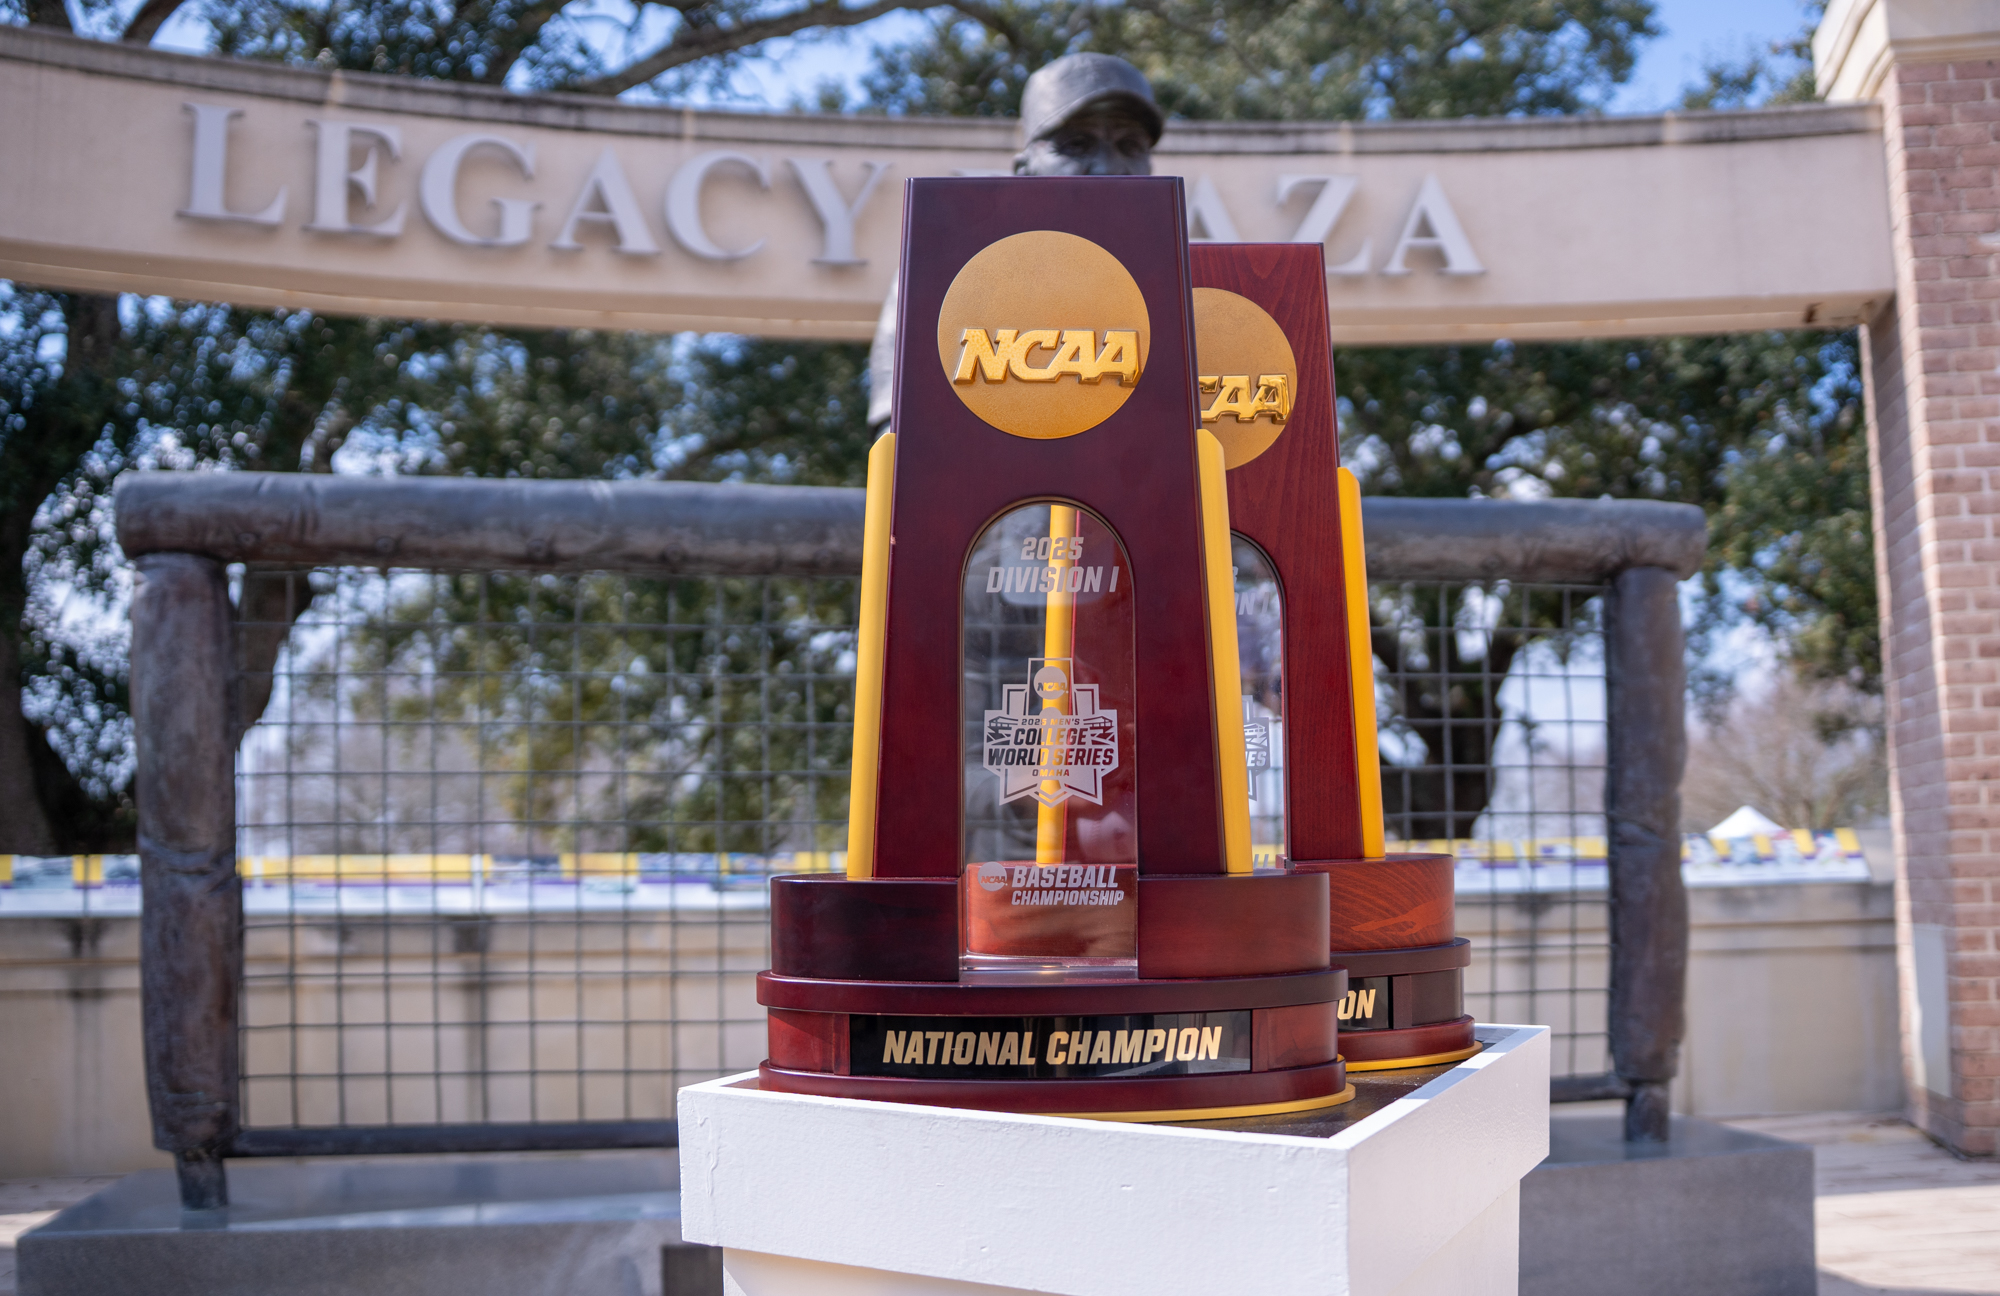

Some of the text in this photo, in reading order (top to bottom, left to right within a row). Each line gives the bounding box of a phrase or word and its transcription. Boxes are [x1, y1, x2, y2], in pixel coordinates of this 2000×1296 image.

[176, 103, 1487, 275] LEGACY AZA
[953, 327, 1142, 388] NCAA
[1020, 536, 1084, 561] 2025
[986, 566, 1119, 593] DIVISION I
[1037, 682, 1067, 692] NCAA
[1021, 718, 1080, 726] 2025 MEN'S
[1013, 727, 1089, 746] COLLEGE
[988, 748, 1114, 766] WORLD SERIES
[1032, 769, 1070, 777] OMAHA
[1011, 865, 1119, 888] BASEBALL
[1011, 890, 1125, 906] CHAMPIONSHIP
[882, 1026, 1223, 1065] NATIONAL CHAMPION
